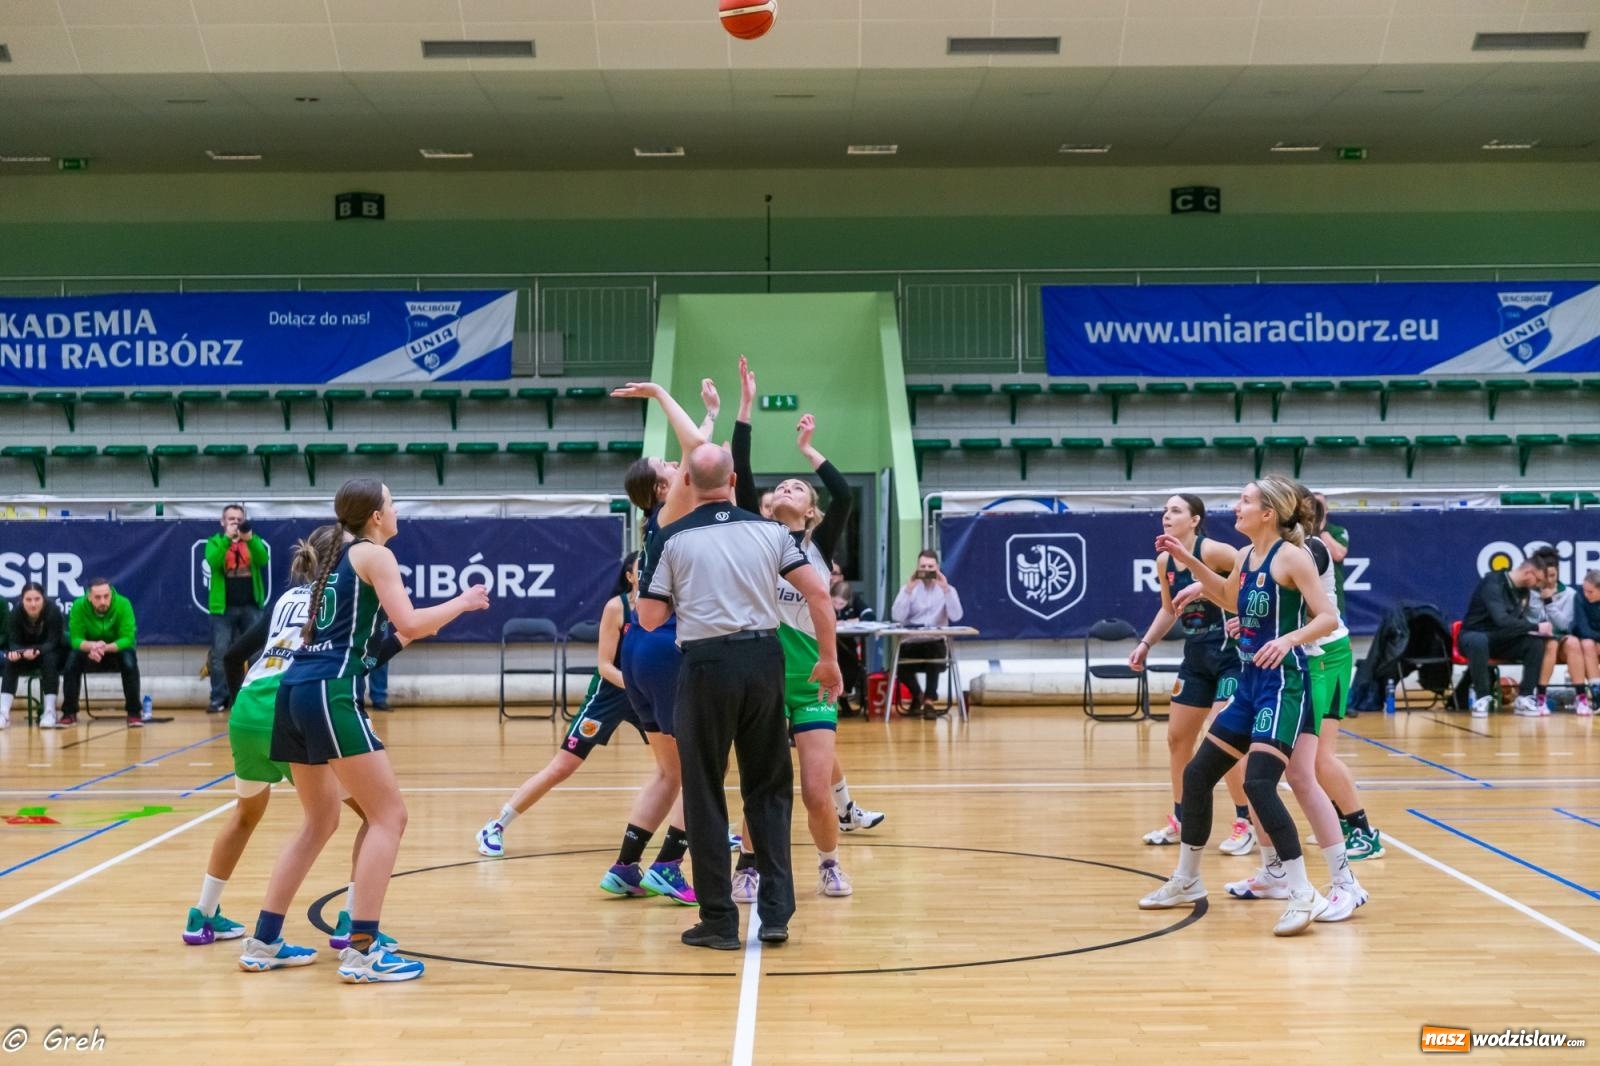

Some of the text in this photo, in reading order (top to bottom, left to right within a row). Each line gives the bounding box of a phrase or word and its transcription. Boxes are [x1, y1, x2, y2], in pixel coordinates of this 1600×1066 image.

[340, 201, 379, 216] B B
[1176, 195, 1217, 210] C C
[269, 311, 371, 328] Dołącz do nas!
[1084, 312, 1440, 344] www.uniaraciborz.eu
[1503, 317, 1546, 345] UNIA
[61, 333, 244, 370] RACIBÓRZ
[410, 327, 453, 354] UNIA
[1246, 590, 1269, 617] 26
[873, 681, 888, 706] 5
